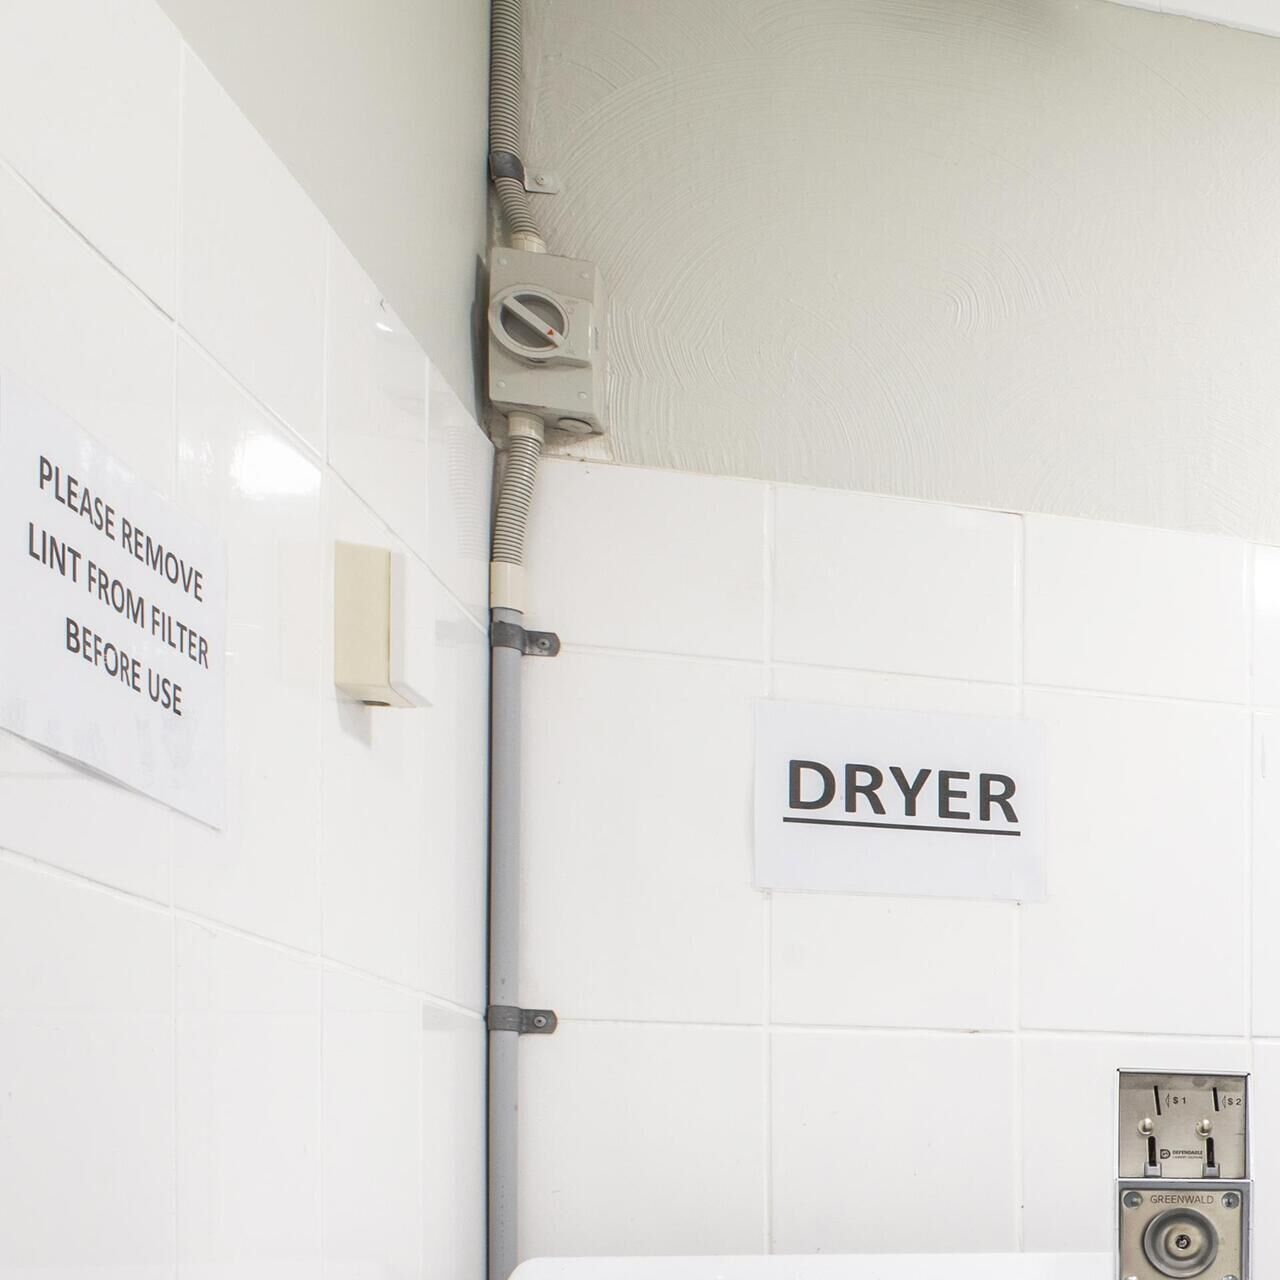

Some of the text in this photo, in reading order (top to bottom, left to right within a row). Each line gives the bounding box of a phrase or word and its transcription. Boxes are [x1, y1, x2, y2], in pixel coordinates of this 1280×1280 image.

[39, 455, 203, 602] PLEASE REMOVE
[29, 522, 209, 669] LINT FROM FILTER
[66, 617, 182, 716] BEFORE USE
[789, 759, 1019, 823] DRYER
[1150, 1194, 1215, 1204] GREENWALD
